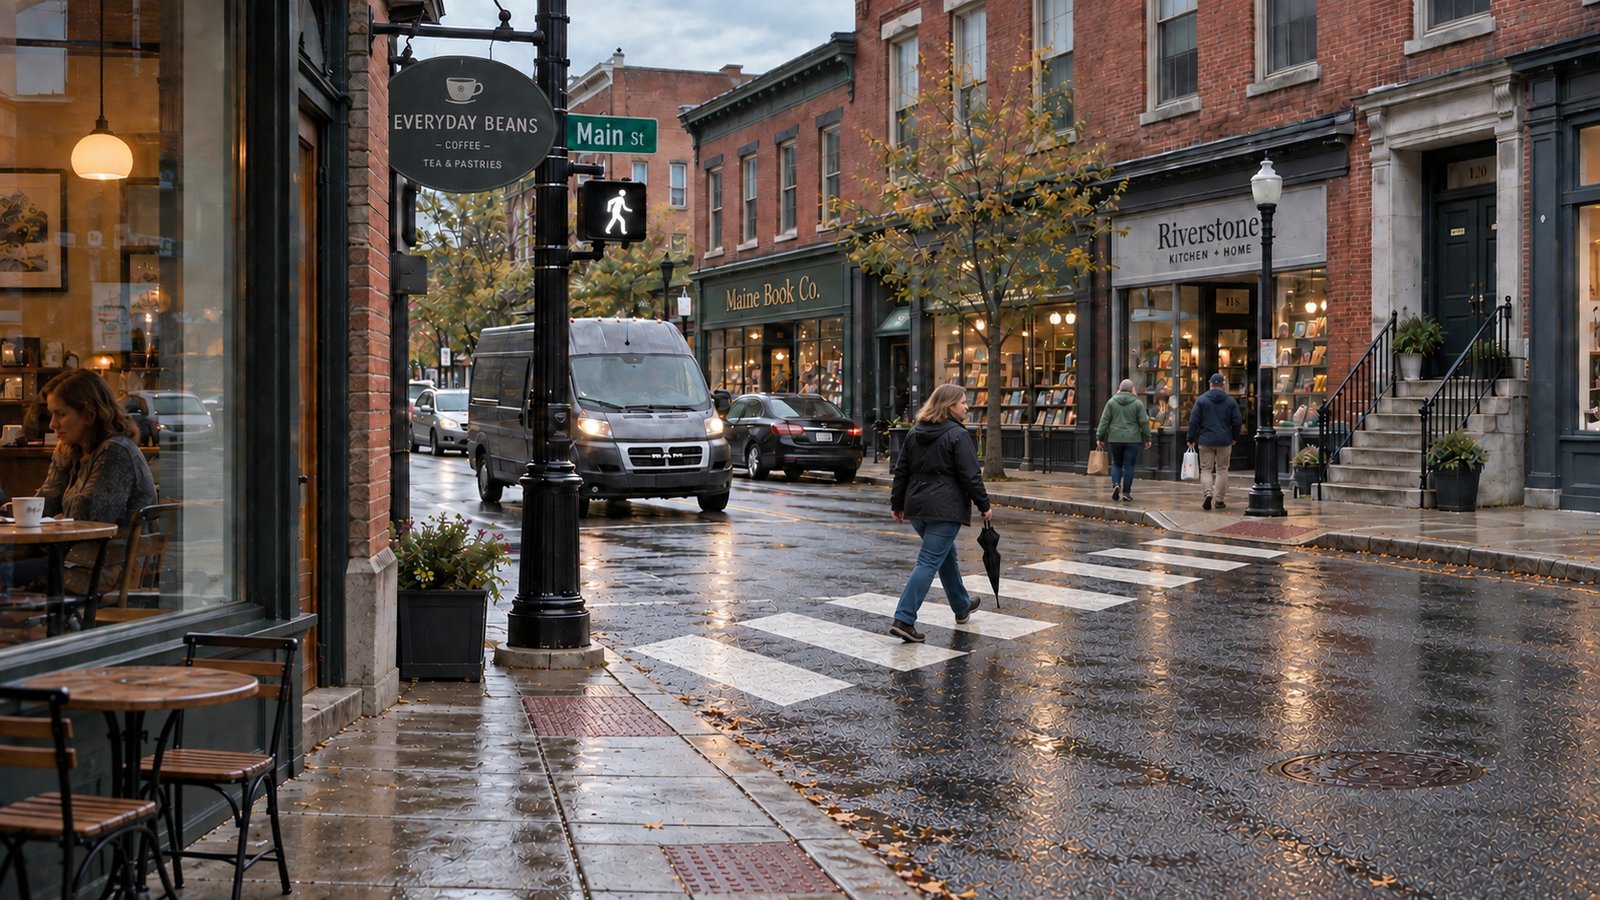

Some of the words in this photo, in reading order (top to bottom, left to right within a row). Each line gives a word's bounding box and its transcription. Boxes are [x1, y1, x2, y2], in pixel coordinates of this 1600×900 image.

[394, 114, 477, 131] EVERYDAY
[484, 116, 538, 134] BEANS
[576, 121, 623, 145] Main
[630, 131, 644, 146] St
[445, 140, 481, 150] COFFEE
[423, 158, 442, 168] TEA
[445, 159, 452, 168] &
[454, 159, 502, 169] PASTRIES
[1470, 166, 1487, 179] 120
[1158, 217, 1259, 250] Riverstone
[1169, 250, 1208, 264] KITCHEN
[1223, 244, 1252, 257] HOME
[726, 287, 760, 311] Maine
[764, 279, 795, 305] Book
[799, 275, 820, 301] Co.
[1226, 297, 1240, 307] 118
